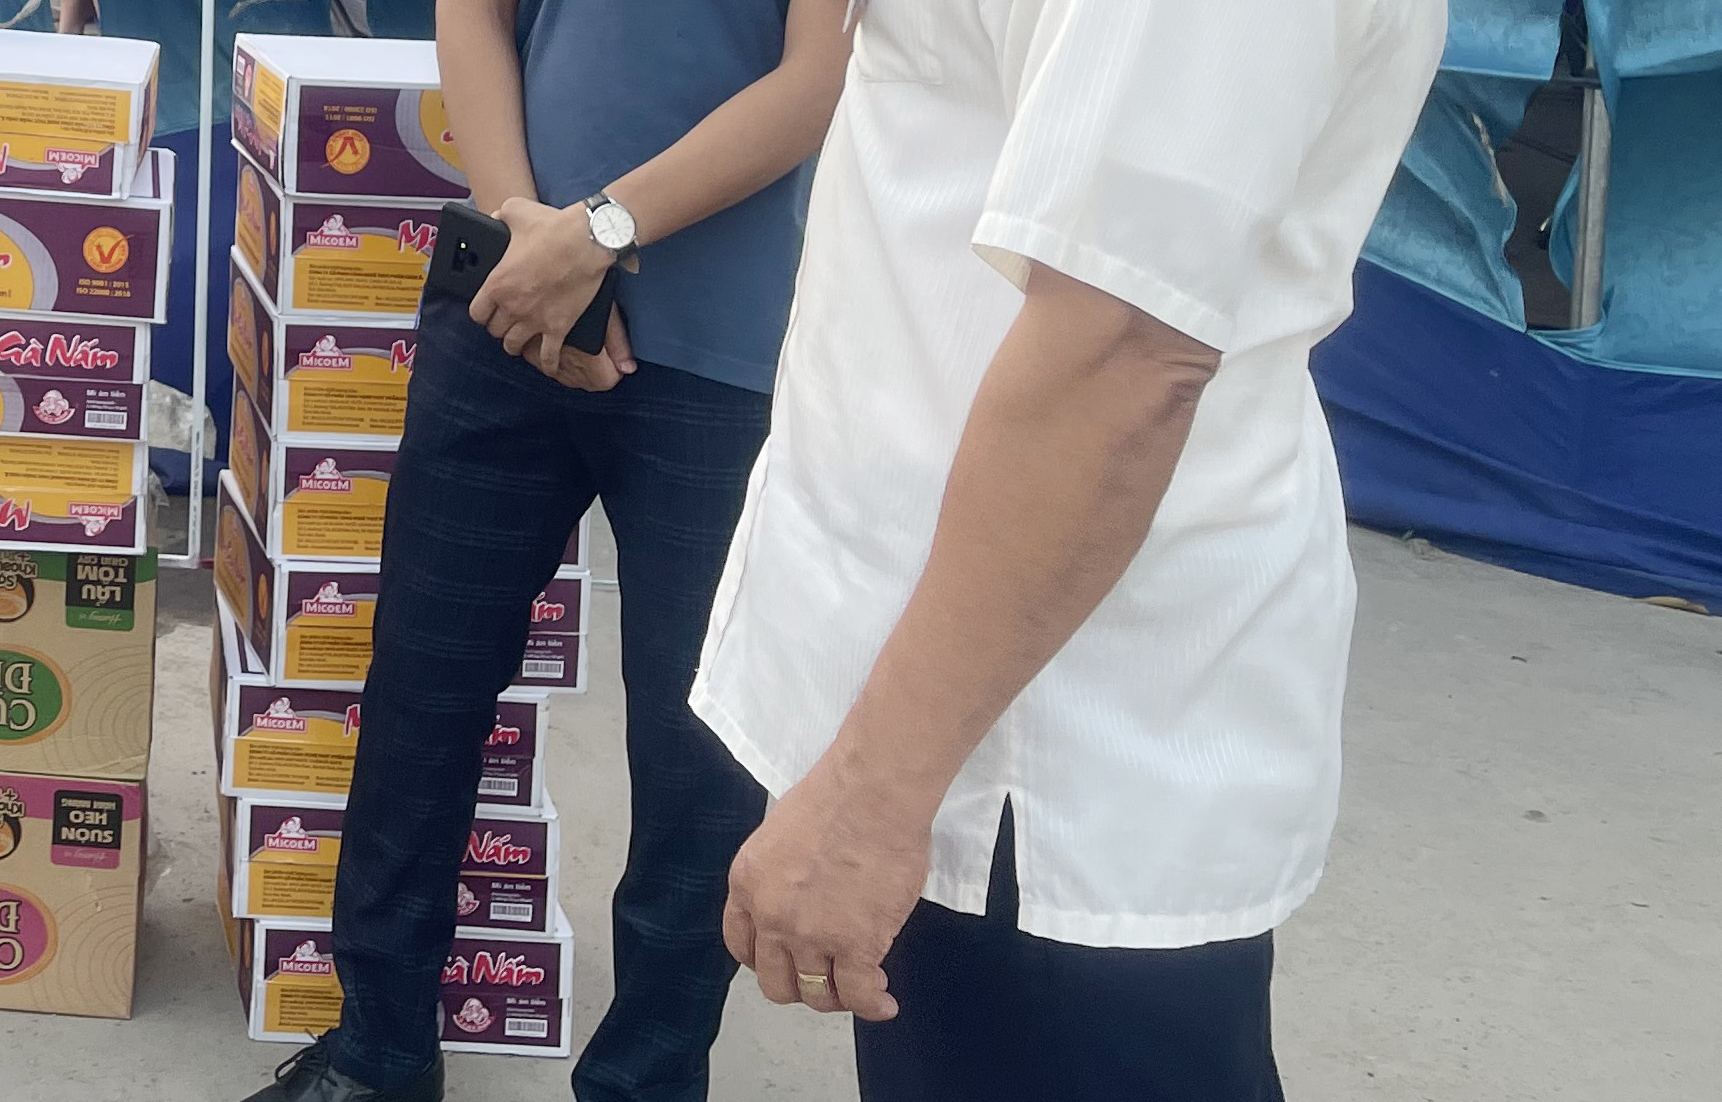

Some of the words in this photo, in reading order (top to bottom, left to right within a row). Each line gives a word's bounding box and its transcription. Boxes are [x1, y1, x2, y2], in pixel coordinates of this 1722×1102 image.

[309, 234, 358, 248] MICOEM
[45, 333, 119, 370] Nấm
[71, 503, 120, 517] MICOEM
[305, 600, 353, 616] MICOEM
[69, 810, 108, 826] HEO
[281, 961, 331, 975] MICOEM
[472, 950, 546, 987] Nấm
